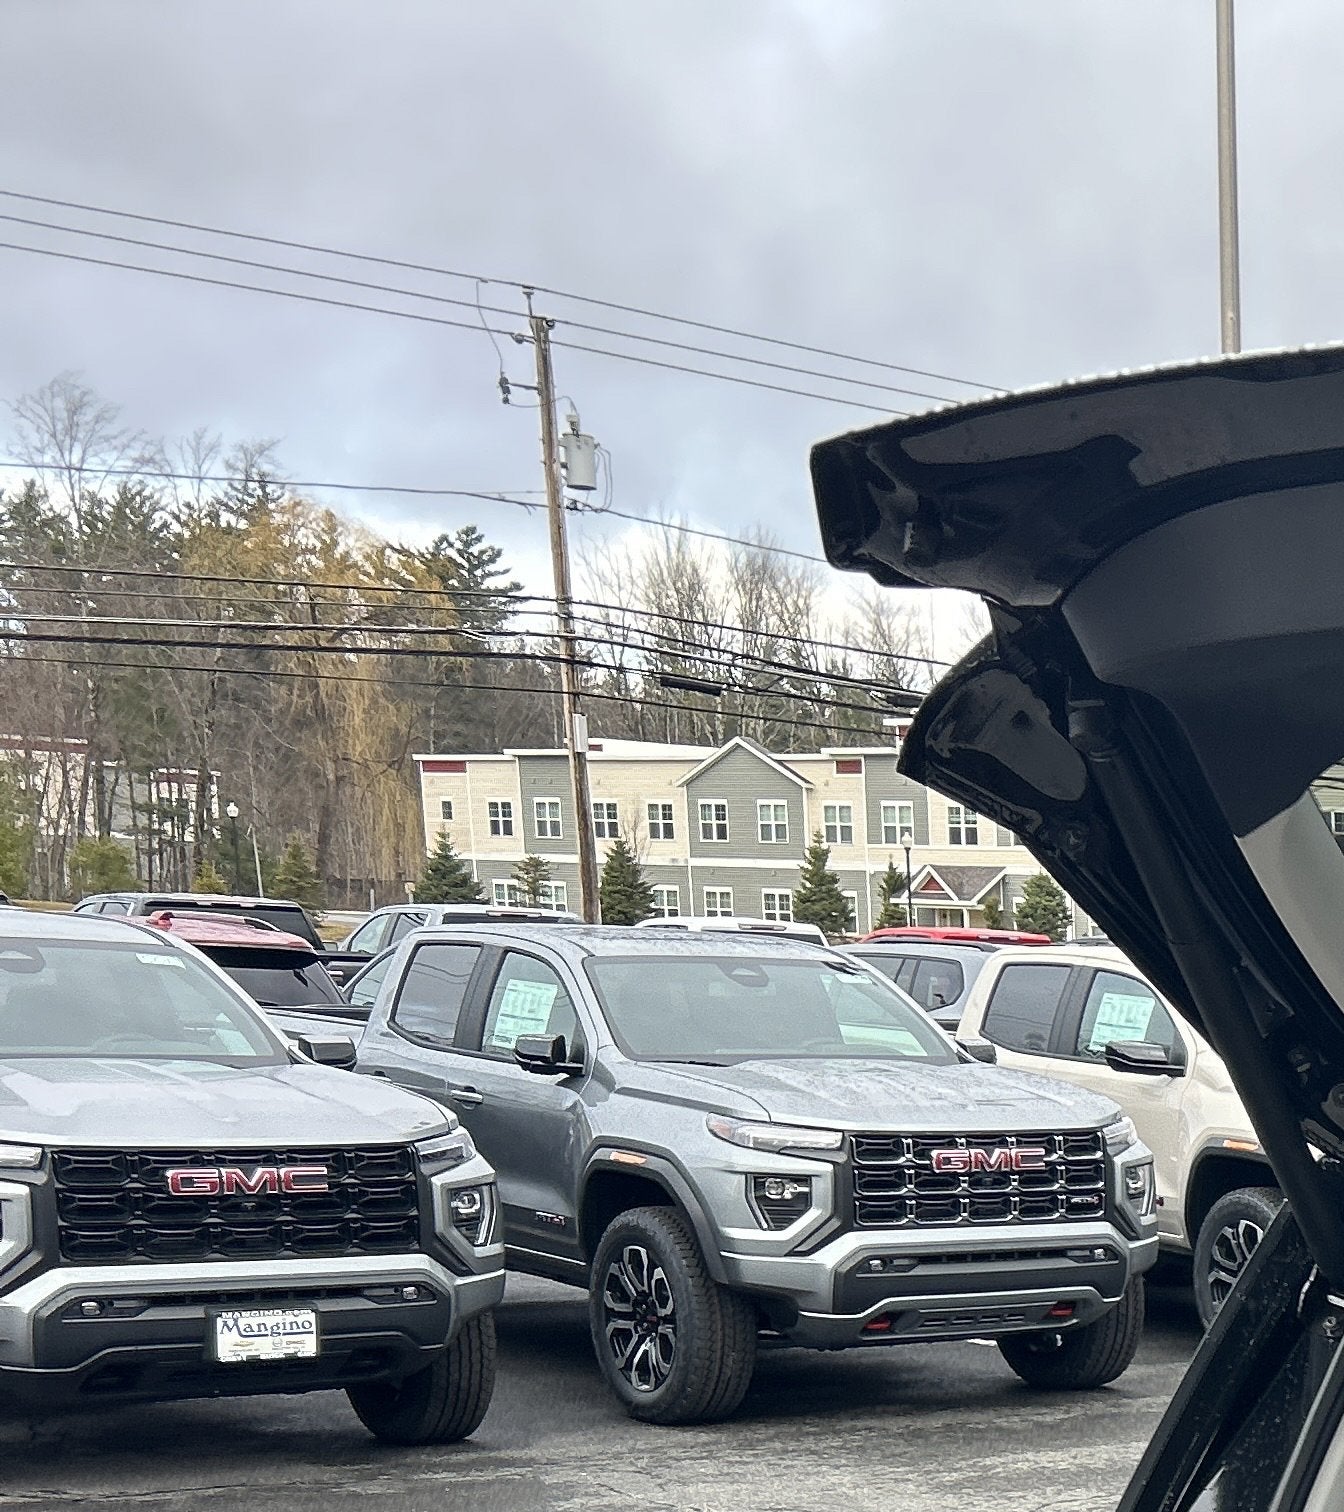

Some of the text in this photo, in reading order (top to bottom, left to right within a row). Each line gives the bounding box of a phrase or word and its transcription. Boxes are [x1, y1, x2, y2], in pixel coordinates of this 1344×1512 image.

[931, 1147, 1046, 1173] GMC
[165, 1166, 329, 1196] GMC
[219, 1318, 314, 1338] Mangino
